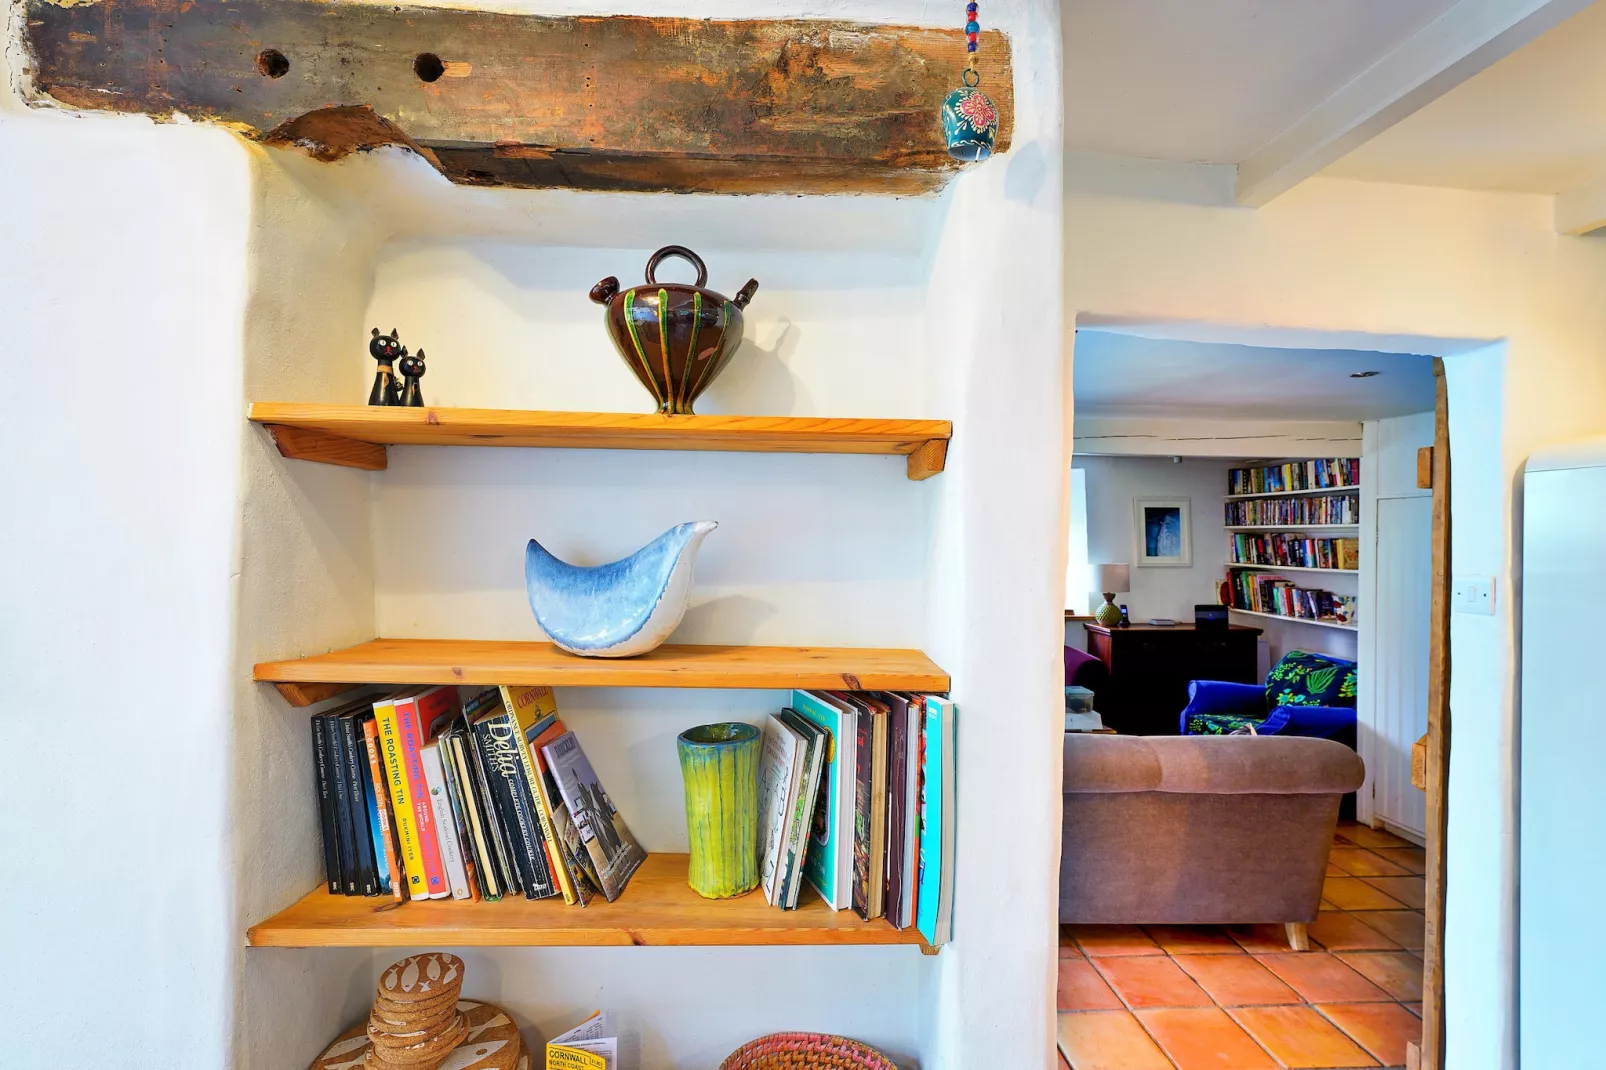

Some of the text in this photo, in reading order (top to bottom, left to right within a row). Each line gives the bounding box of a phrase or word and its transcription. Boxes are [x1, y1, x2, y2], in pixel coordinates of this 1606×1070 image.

[517, 686, 548, 708] CORNWALL
[366, 737, 376, 764] COOKS
[382, 718, 404, 804] THE ROASTING TIN
[403, 712, 424, 798] THE ROASTING TIN
[487, 721, 519, 778] Delia
[506, 700, 519, 735] ORDNANCE
[516, 736, 527, 760] SURVEY
[524, 761, 534, 785] LEISURE
[539, 809, 552, 843] CORNWALL
[402, 818, 410, 845] RUKMINI
[436, 798, 445, 818] English
[445, 840, 455, 863] Cookery
[508, 779, 535, 860] COMPLETE COOKERY COURSE
[550, 1050, 588, 1065] CORNWALL
